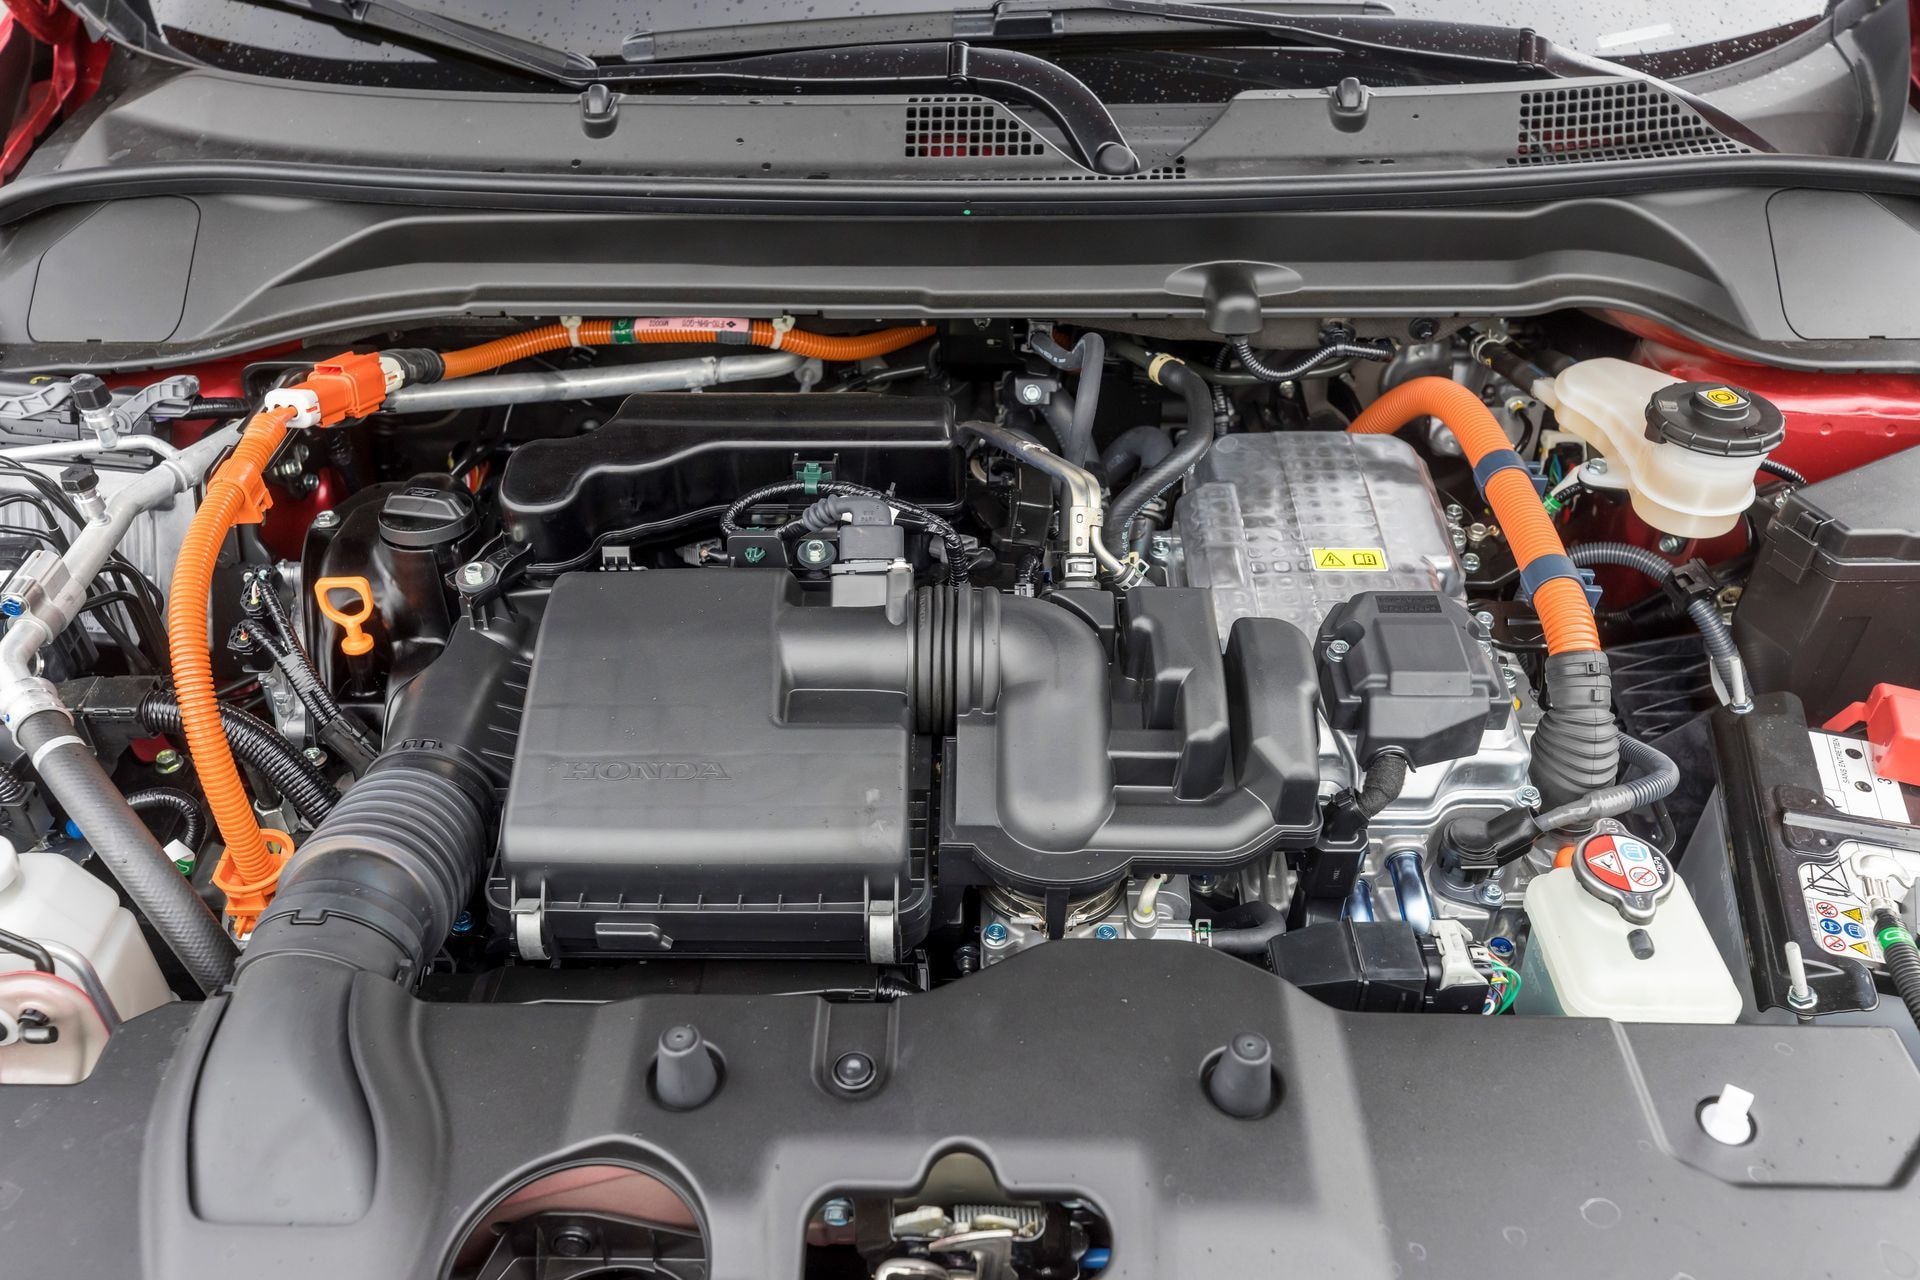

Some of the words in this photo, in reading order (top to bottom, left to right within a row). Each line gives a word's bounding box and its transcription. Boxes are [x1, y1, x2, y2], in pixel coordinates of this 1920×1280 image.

[1832, 737, 1847, 768] ENTRETIEN
[562, 760, 733, 781] HONDA
[1839, 768, 1850, 784] SANS
